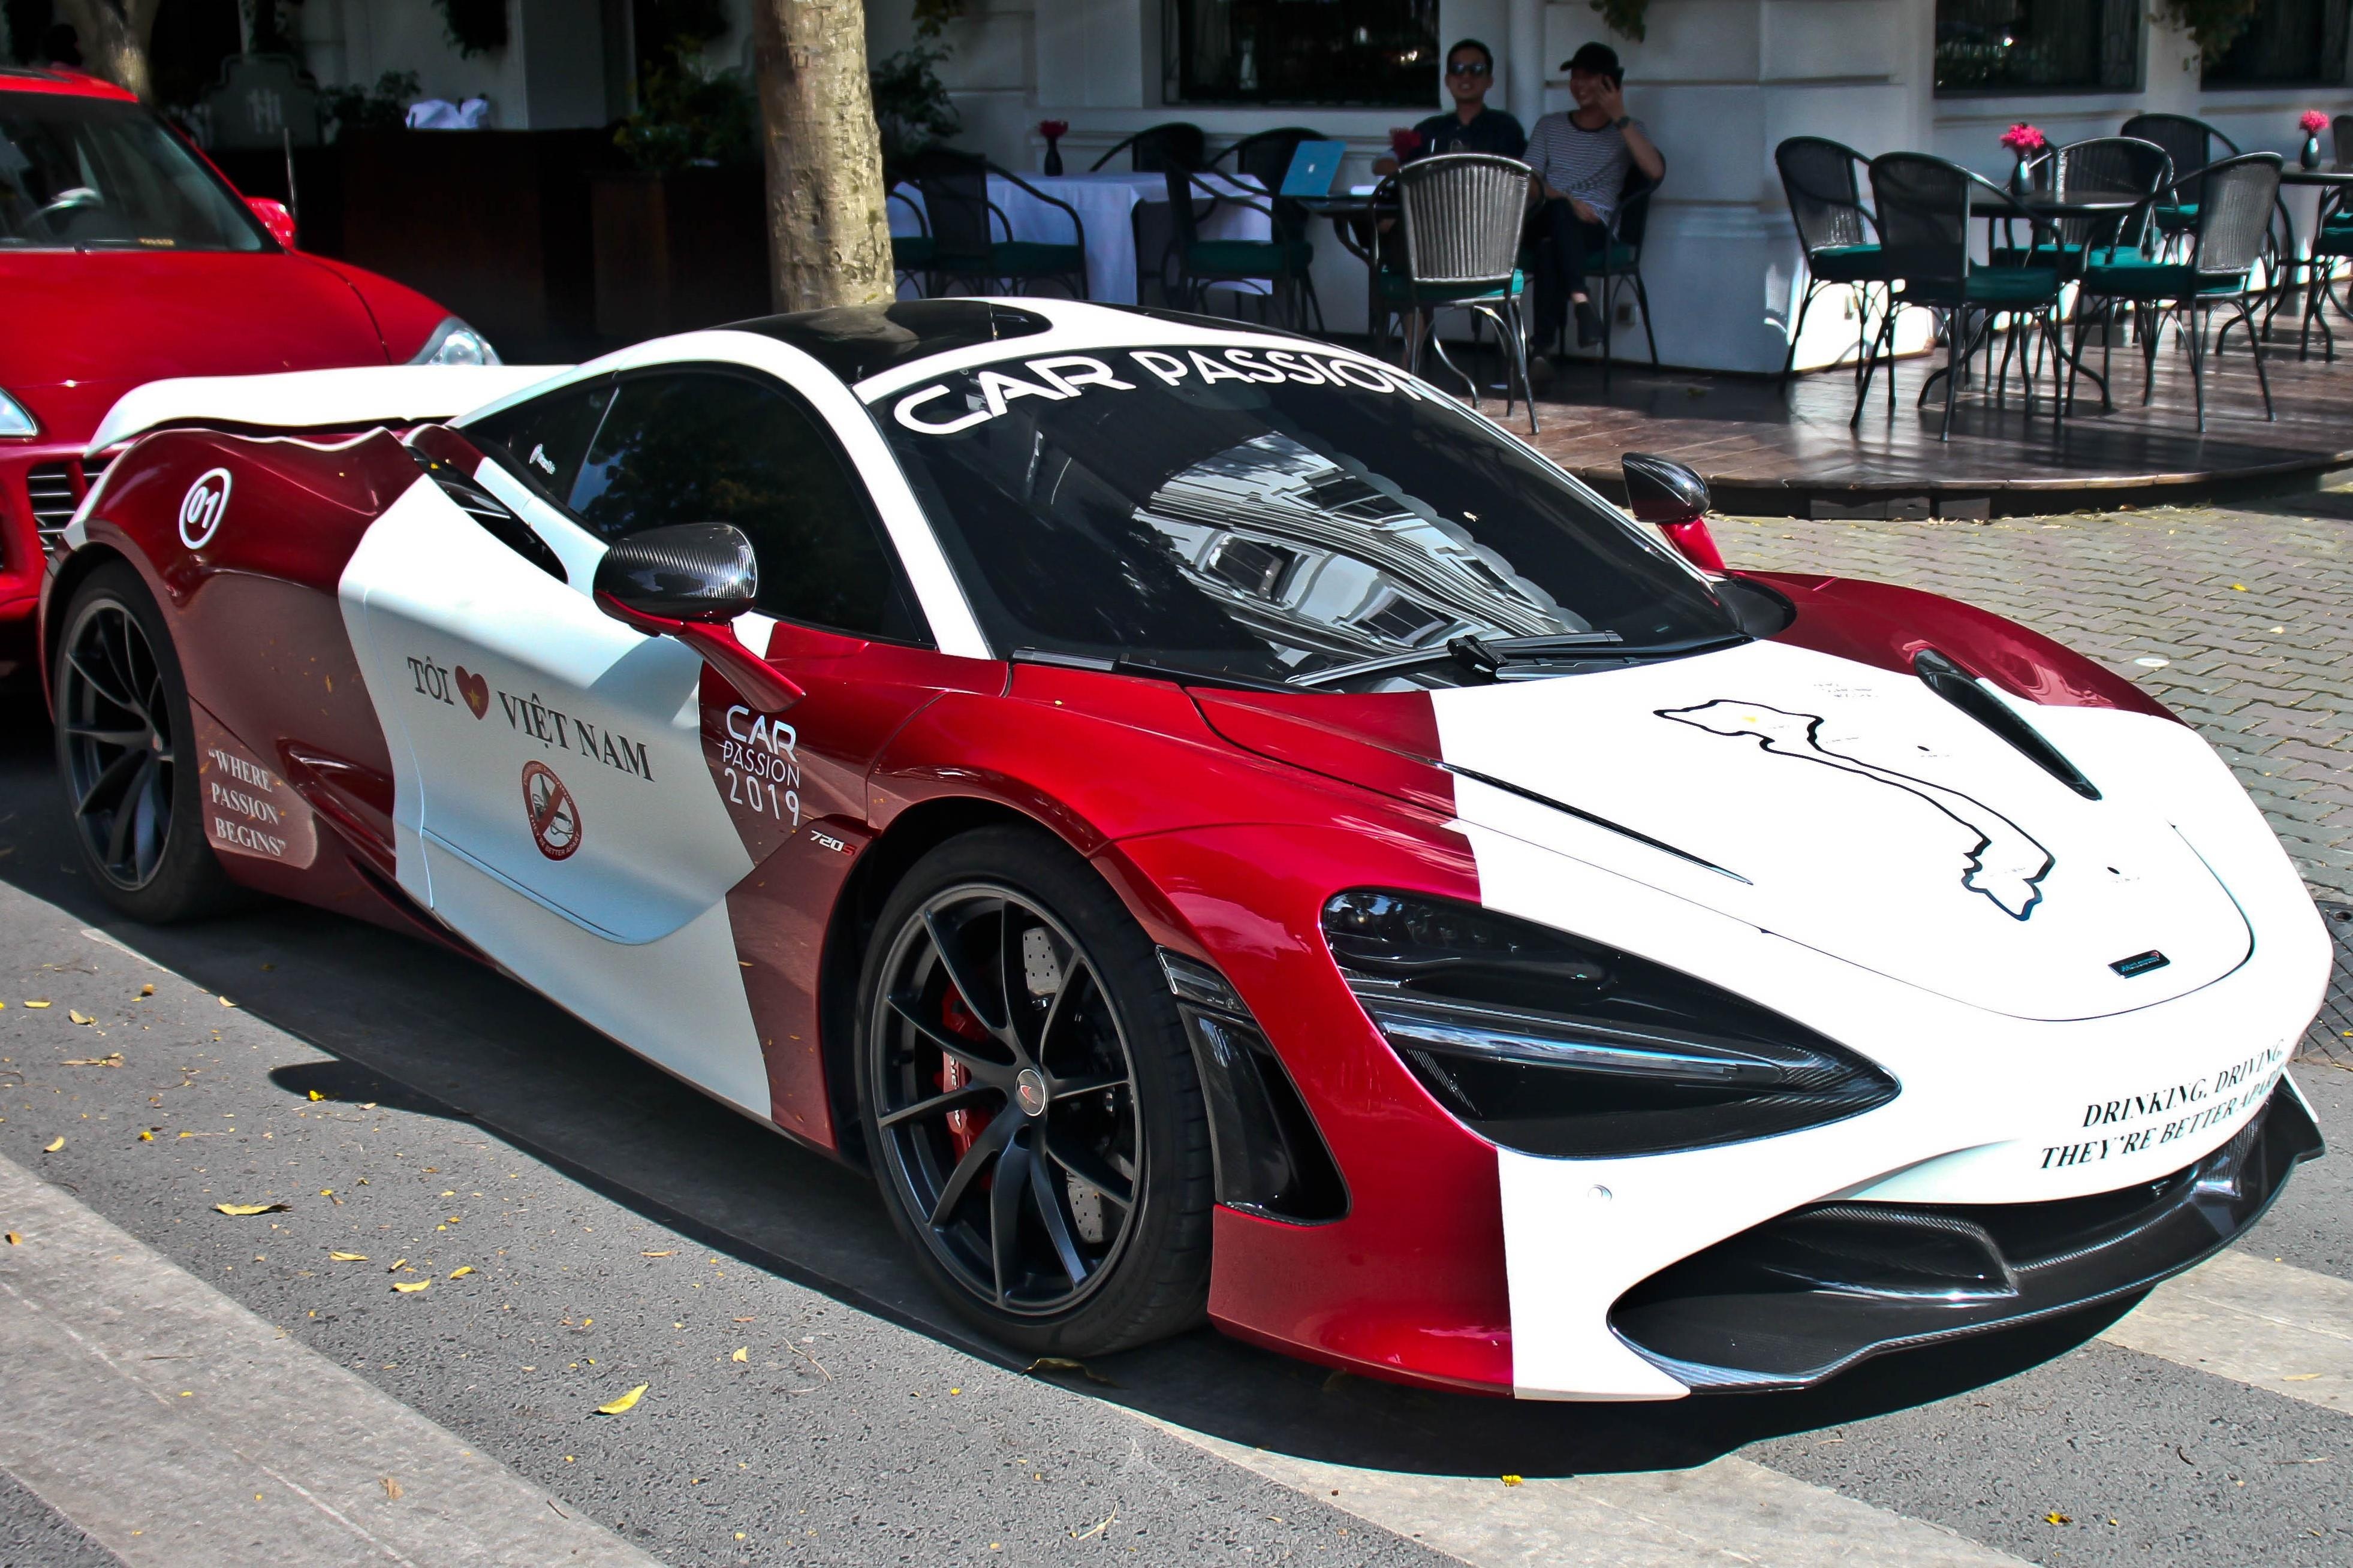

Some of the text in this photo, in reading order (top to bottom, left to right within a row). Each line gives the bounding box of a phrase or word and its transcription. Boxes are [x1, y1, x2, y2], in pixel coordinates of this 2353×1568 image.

[894, 349, 1453, 435] CAR PASSION
[186, 486, 221, 529] 01
[407, 655, 655, 783] TÔI VIỆT NAM
[726, 705, 798, 763] CAR
[723, 740, 800, 789] PASSION
[211, 782, 279, 826] PASSION
[724, 767, 799, 827] 2019
[810, 830, 857, 856] 720S
[2159, 1097, 2238, 1144] BETTER
